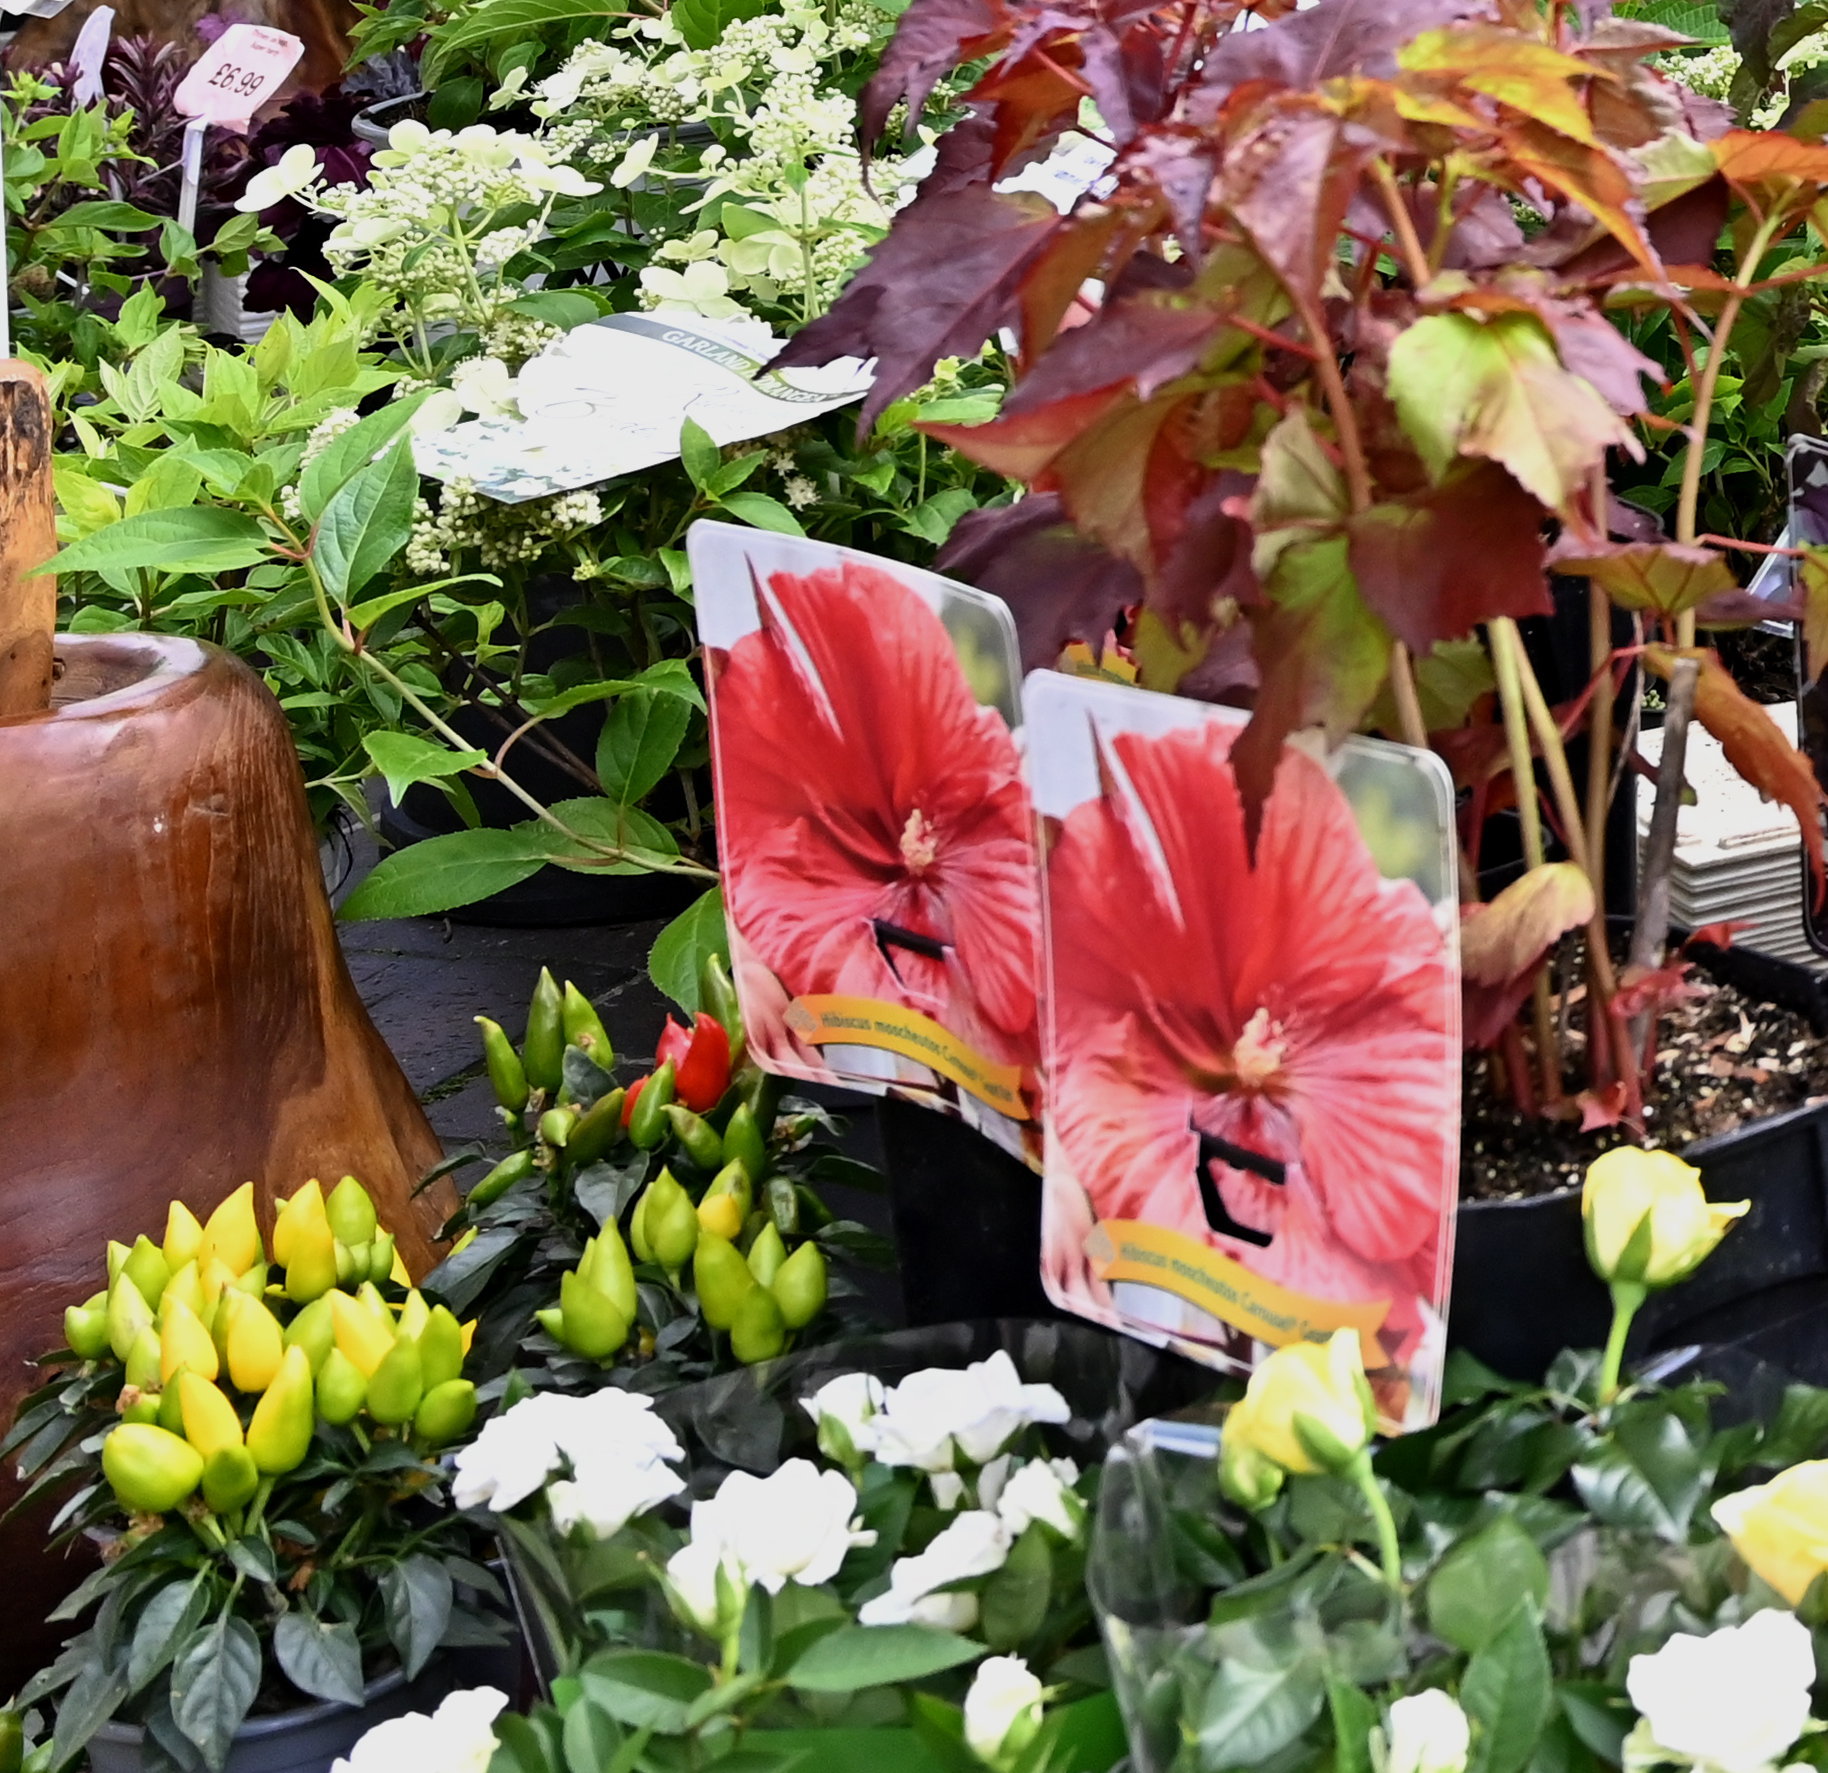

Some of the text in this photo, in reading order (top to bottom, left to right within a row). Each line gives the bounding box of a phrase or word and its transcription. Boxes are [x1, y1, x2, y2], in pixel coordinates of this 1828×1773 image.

[207, 63, 265, 97] £6.99
[662, 330, 752, 372] GARLAND
[820, 1012, 873, 1032] Hibiscus
